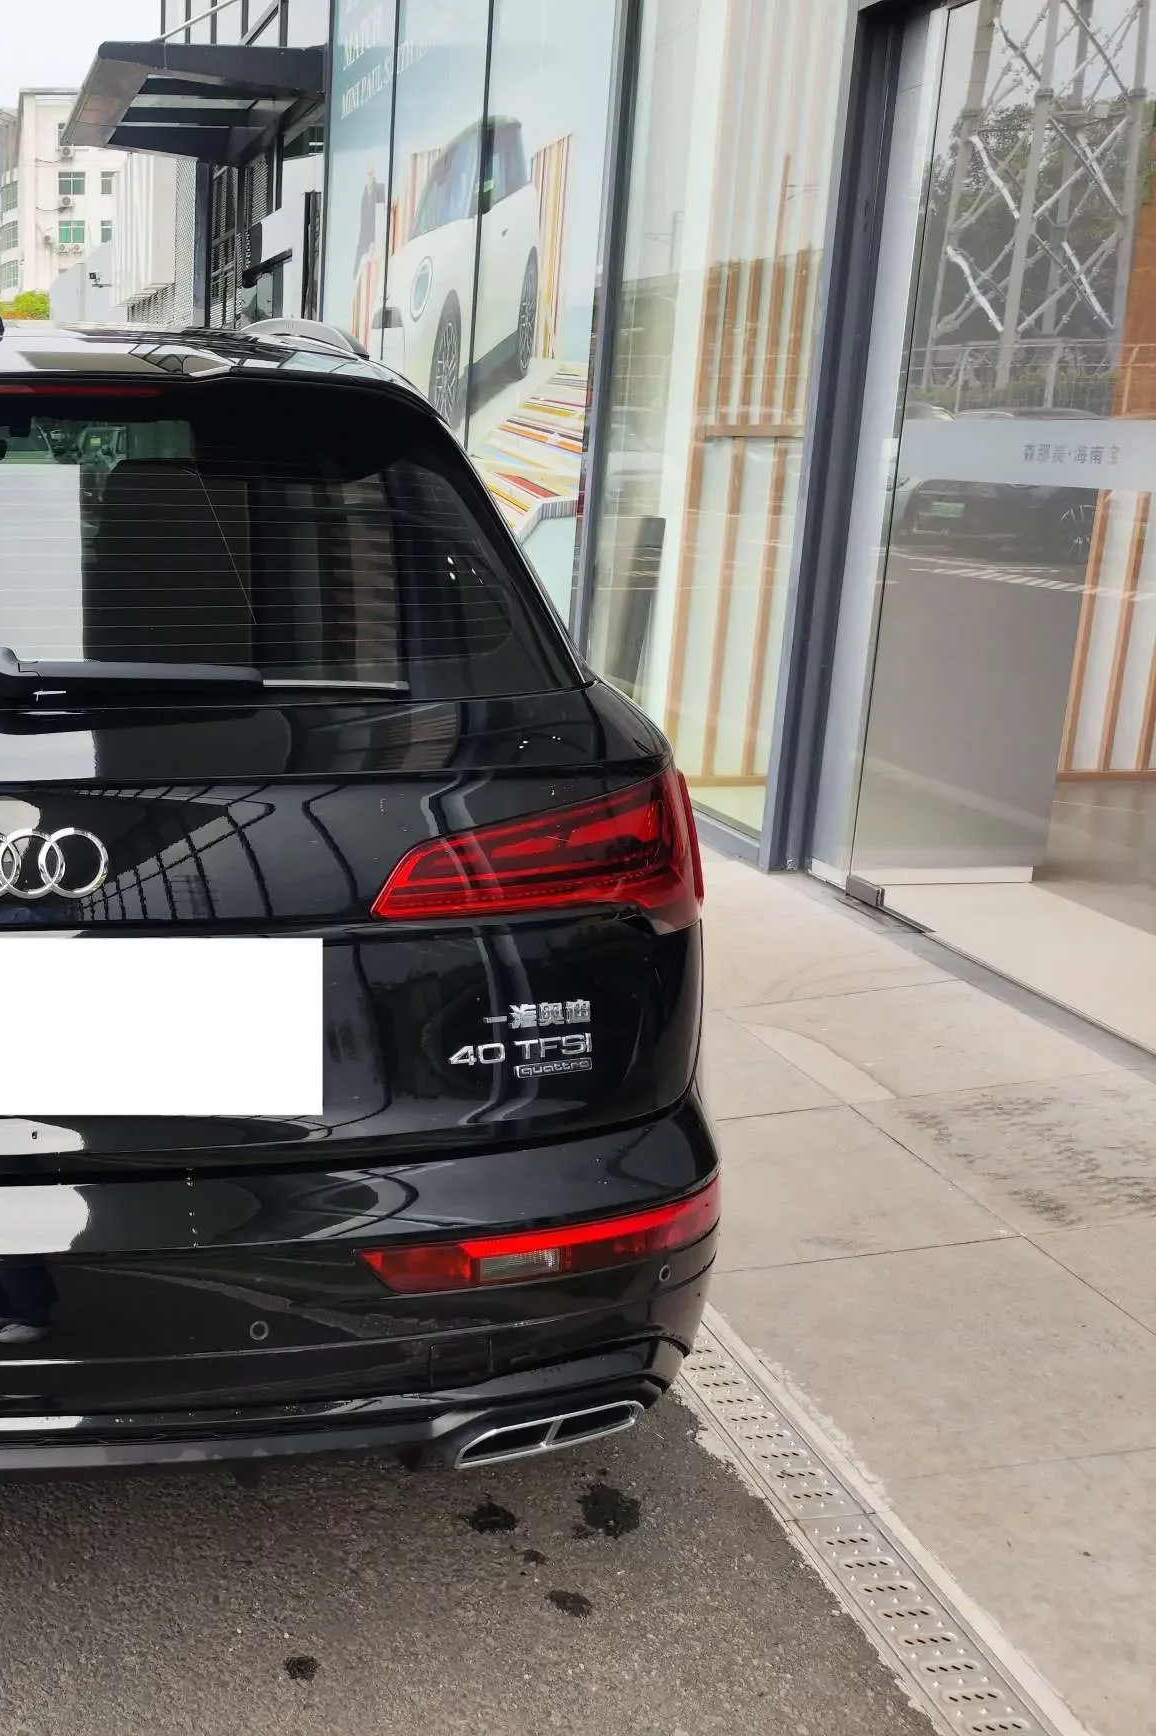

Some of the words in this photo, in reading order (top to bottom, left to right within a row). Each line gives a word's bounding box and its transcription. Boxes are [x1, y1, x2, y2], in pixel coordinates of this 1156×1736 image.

[341, 81, 360, 119] MINI
[360, 63, 383, 105] PAUL
[448, 1042, 506, 1066] 40
[513, 1032, 593, 1060] TFSI
[518, 1059, 591, 1078] quattro
